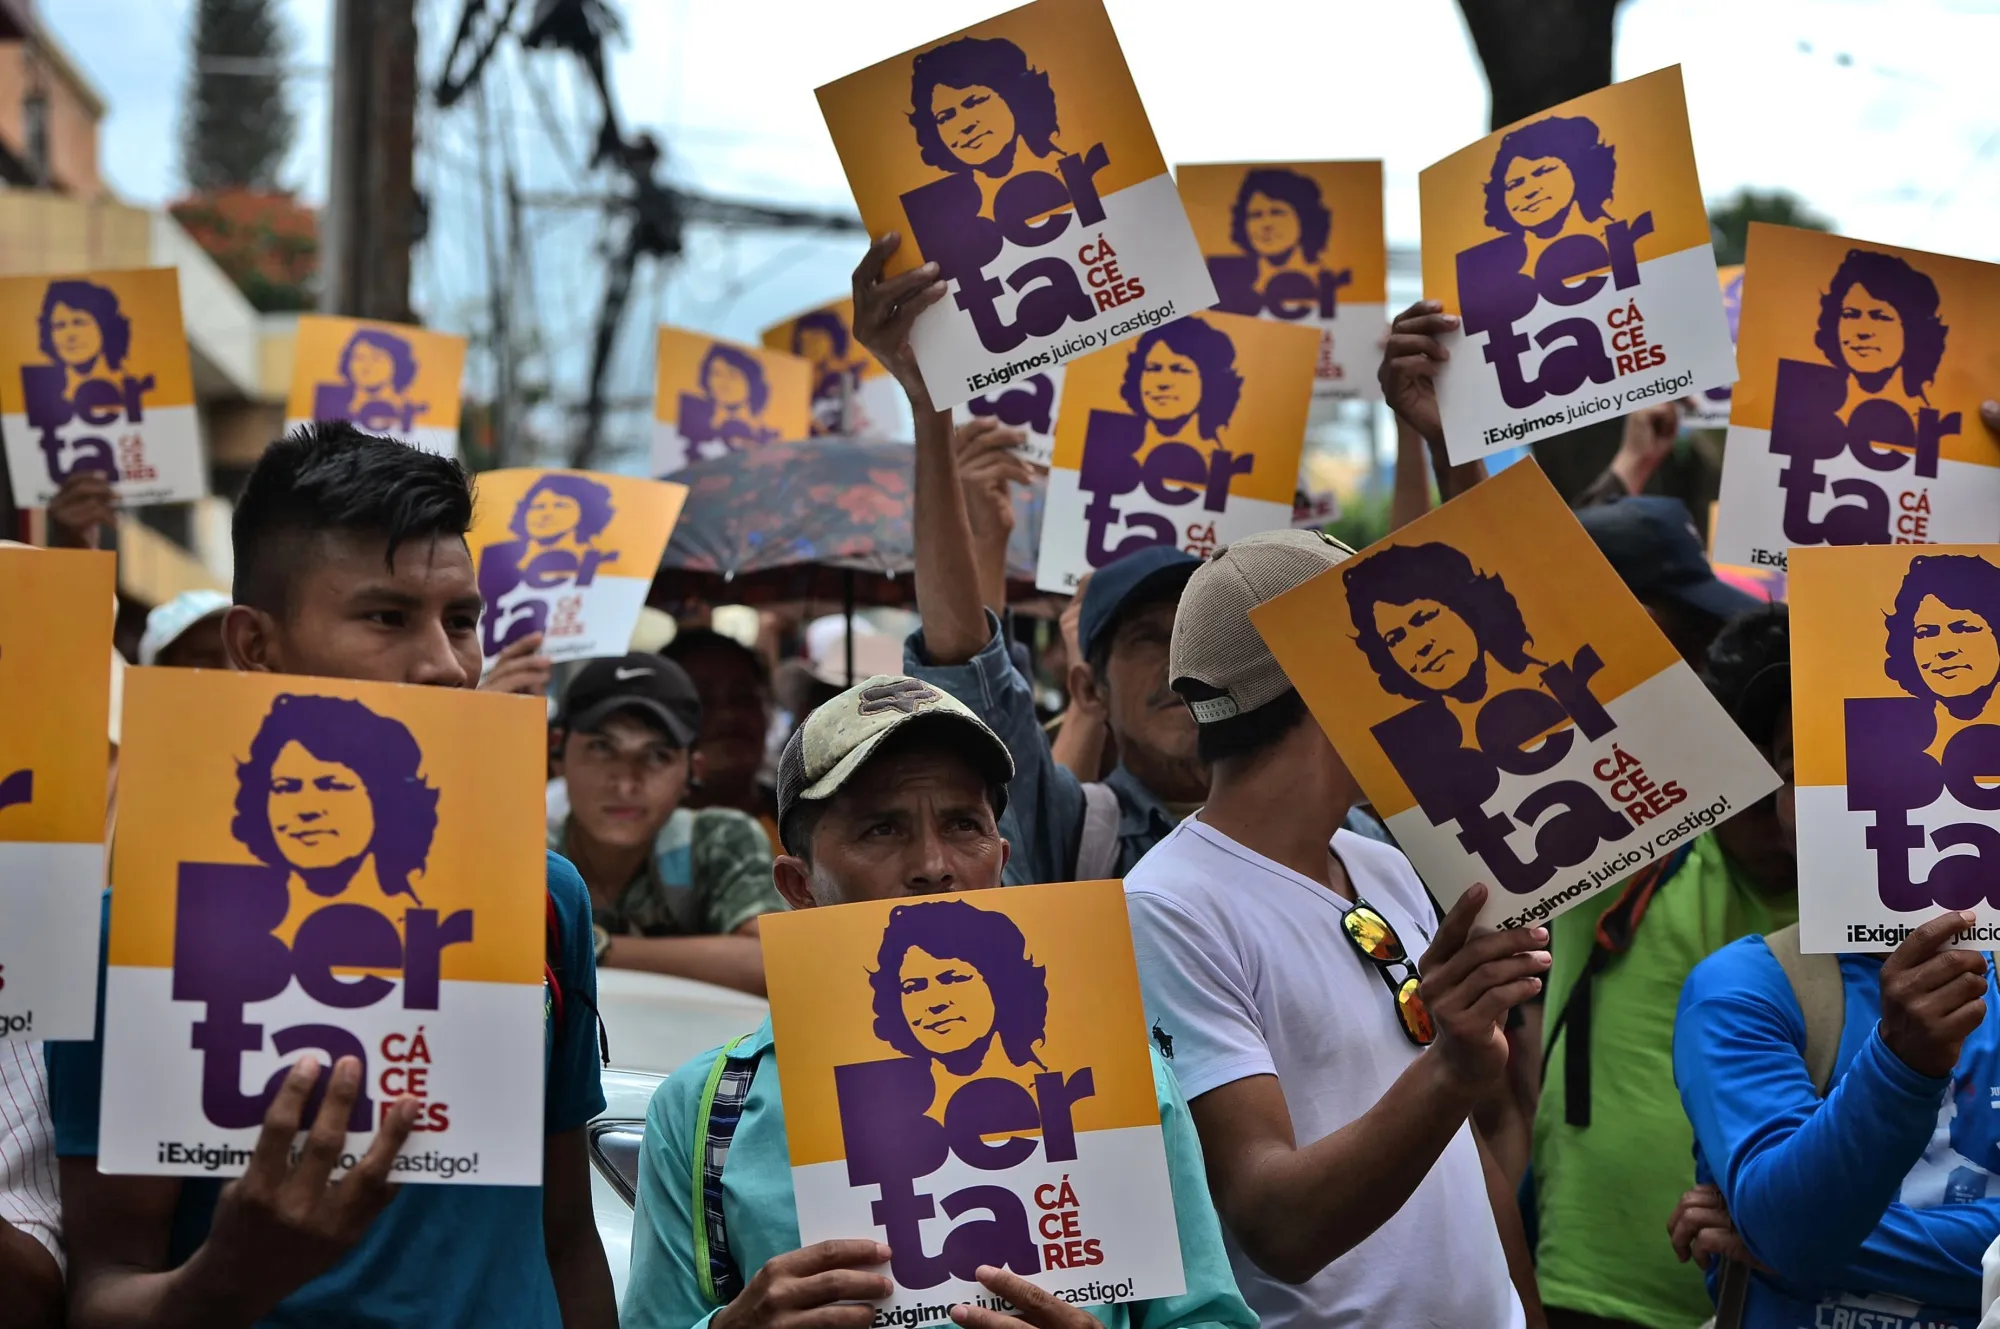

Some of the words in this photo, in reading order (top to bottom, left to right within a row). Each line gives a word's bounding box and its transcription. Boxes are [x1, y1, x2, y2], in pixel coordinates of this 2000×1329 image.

[899, 142, 1111, 282] Ber
[1078, 232, 1117, 266] CÁ
[1087, 260, 1123, 288] CE
[1456, 210, 1654, 337] Ber
[953, 256, 1097, 354] ta
[1094, 277, 1145, 313] RES
[1607, 298, 1645, 329] CÁ
[966, 351, 1051, 392] ¡Exigimos
[1050, 334, 1096, 364] juicio
[1097, 329, 1107, 346] y
[1110, 300, 1176, 336] castigo!
[1612, 325, 1647, 352] CE
[1482, 316, 1616, 409] ta
[1616, 344, 1666, 376] RES
[21, 365, 156, 429] Ber
[1483, 411, 1565, 445] ¡Exigimos
[1566, 397, 1611, 424] juicio
[1612, 394, 1623, 404] y
[1626, 370, 1694, 402] castigo!
[1769, 358, 1962, 479] Ber
[1078, 409, 1254, 513] Ber
[1778, 458, 1893, 546] ta
[1899, 488, 1931, 515] CÁ
[1186, 520, 1217, 544] CÁ
[1897, 515, 1928, 537] CE
[1369, 643, 1618, 827] Ber
[1593, 743, 1641, 782] CÁ
[1610, 768, 1657, 802] CE
[1624, 780, 1688, 826] RES
[1455, 779, 1636, 894] ta
[1587, 851, 1642, 888] juicio
[1640, 841, 1656, 859] y
[1656, 795, 1732, 847] castigo!
[172, 861, 474, 1011] Ber
[380, 1025, 432, 1064] CÁ
[379, 1067, 429, 1097] CE
[833, 1057, 1096, 1188] Ber
[391, 1152, 480, 1178] astigo!
[1034, 1174, 1080, 1211] CÁ
[870, 1180, 1042, 1291] ta
[1038, 1211, 1082, 1240] CE
[1042, 1238, 1105, 1271] RES
